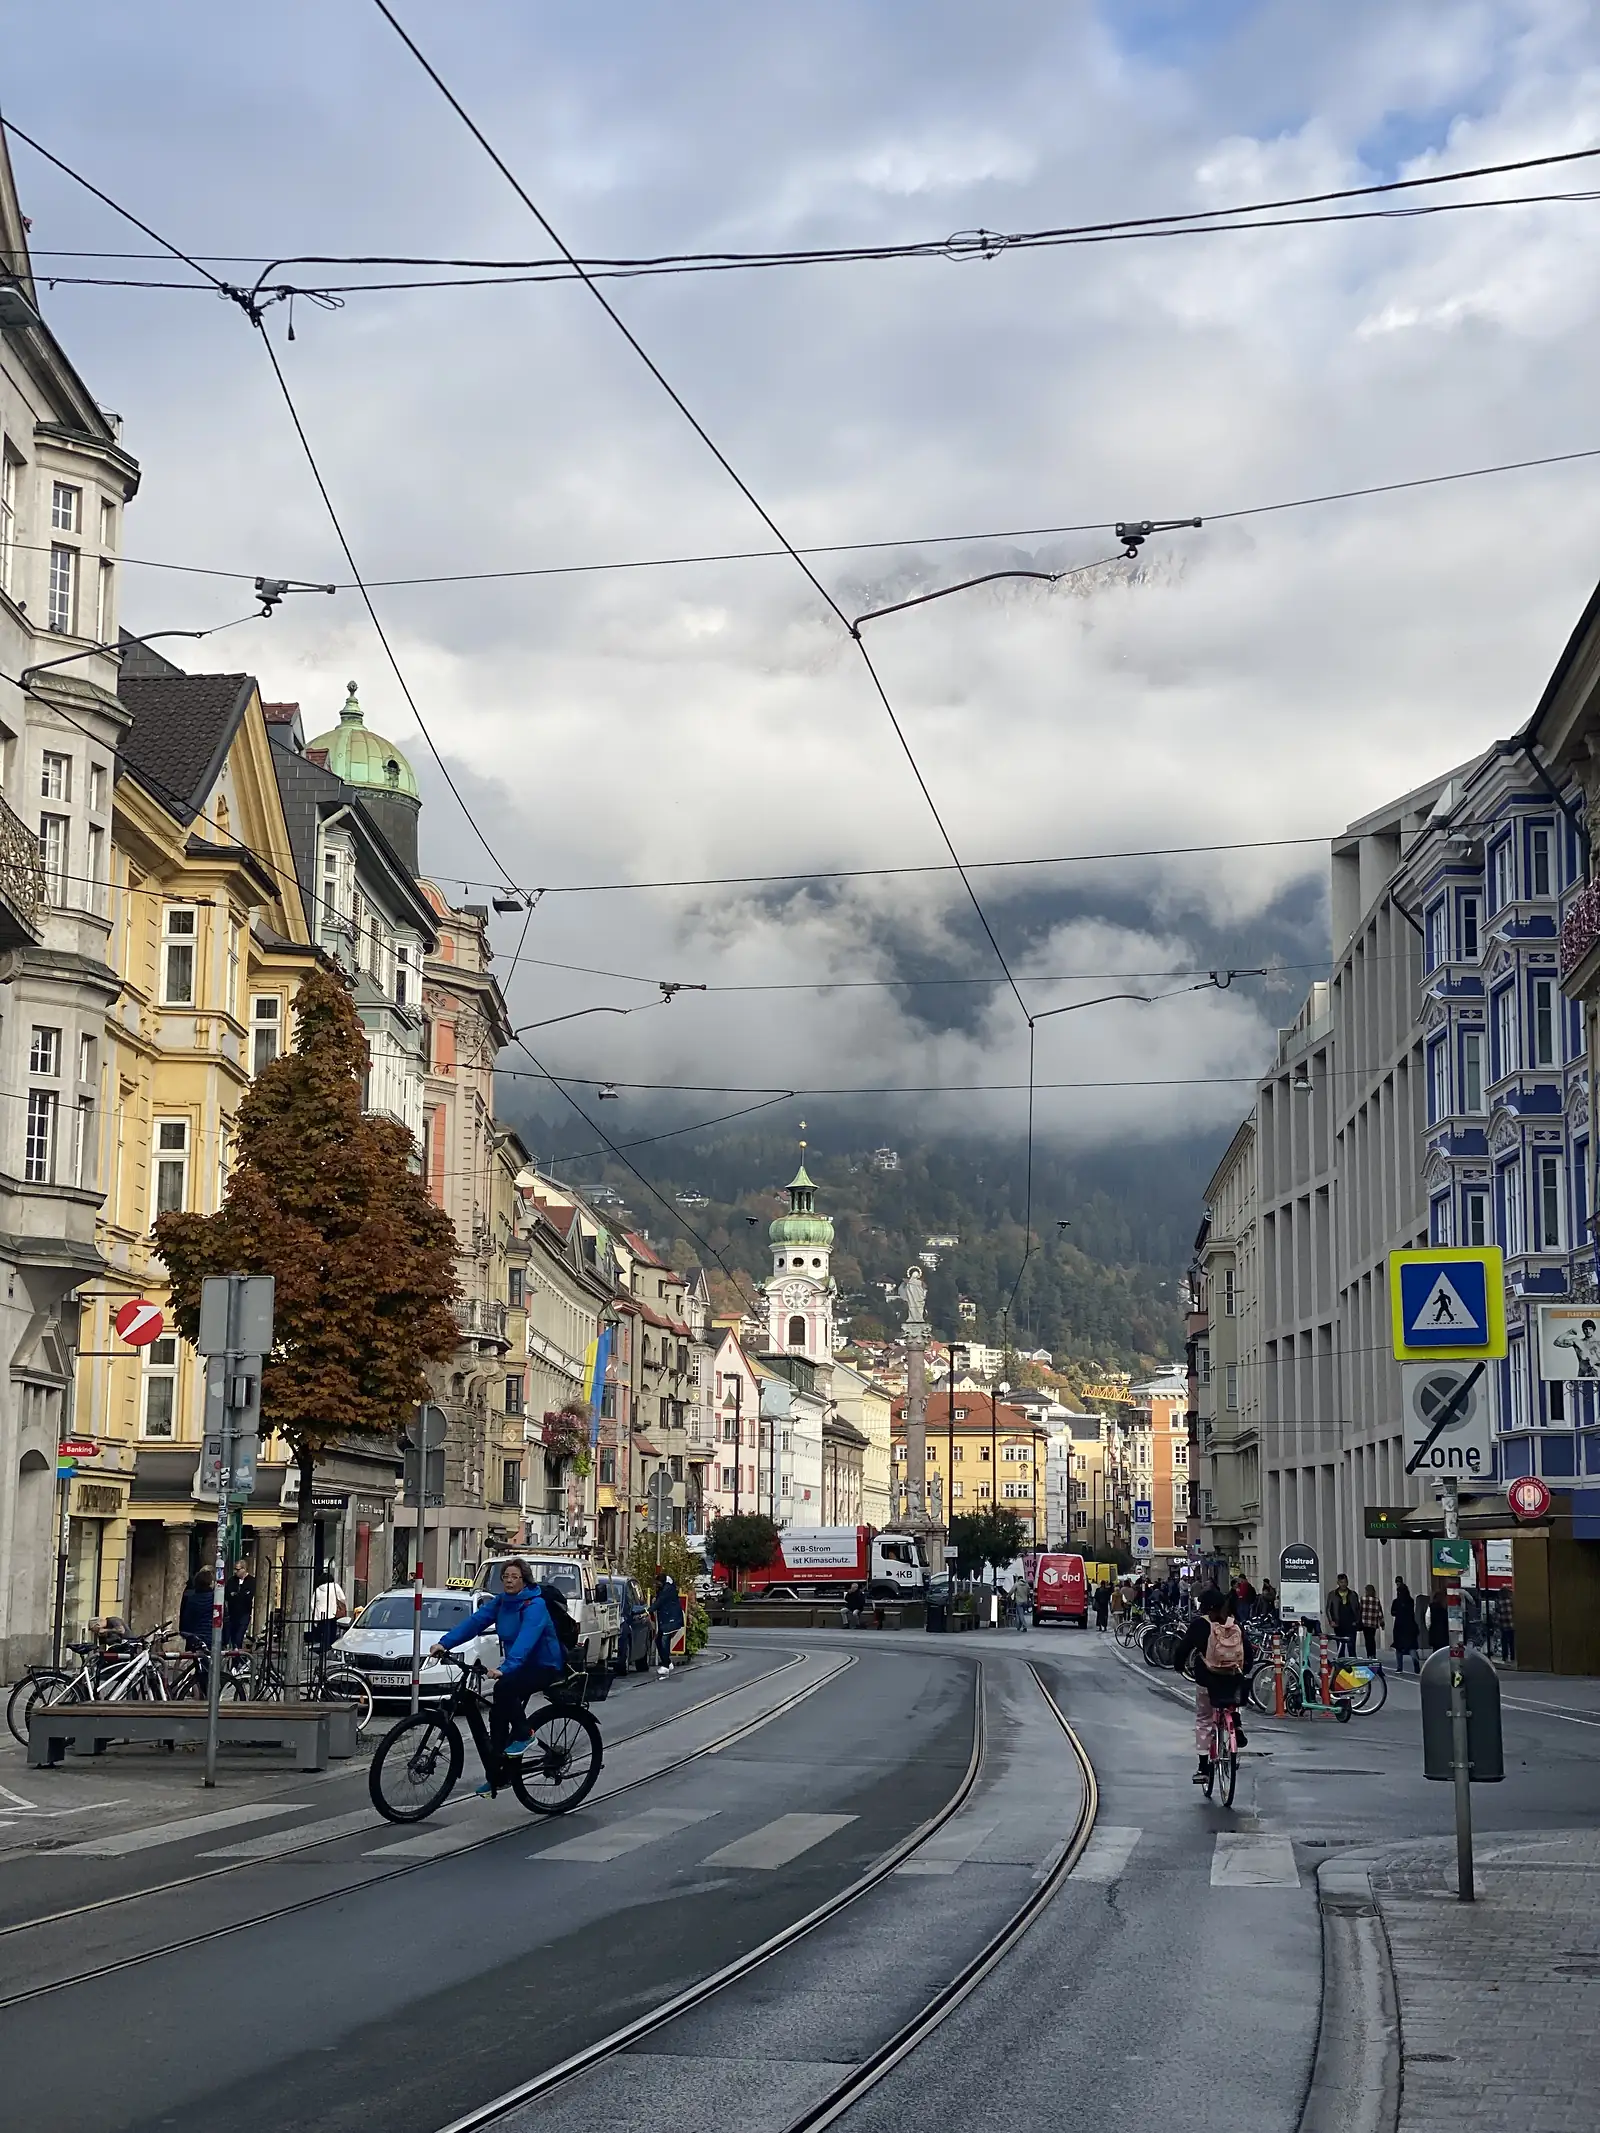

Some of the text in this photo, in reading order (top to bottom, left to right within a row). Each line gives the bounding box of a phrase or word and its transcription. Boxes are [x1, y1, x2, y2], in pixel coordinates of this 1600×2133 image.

[66, 1446, 93, 1454] Banking
[1413, 1440, 1480, 1469] Zone
[803, 1556, 851, 1564] Klimaschutz.
[1284, 1557, 1314, 1565] Stadtrad
[1061, 1572, 1080, 1583] dpd
[450, 1578, 470, 1586] TAXI
[380, 1676, 395, 1684] 1515
[396, 1676, 405, 1684] TX
